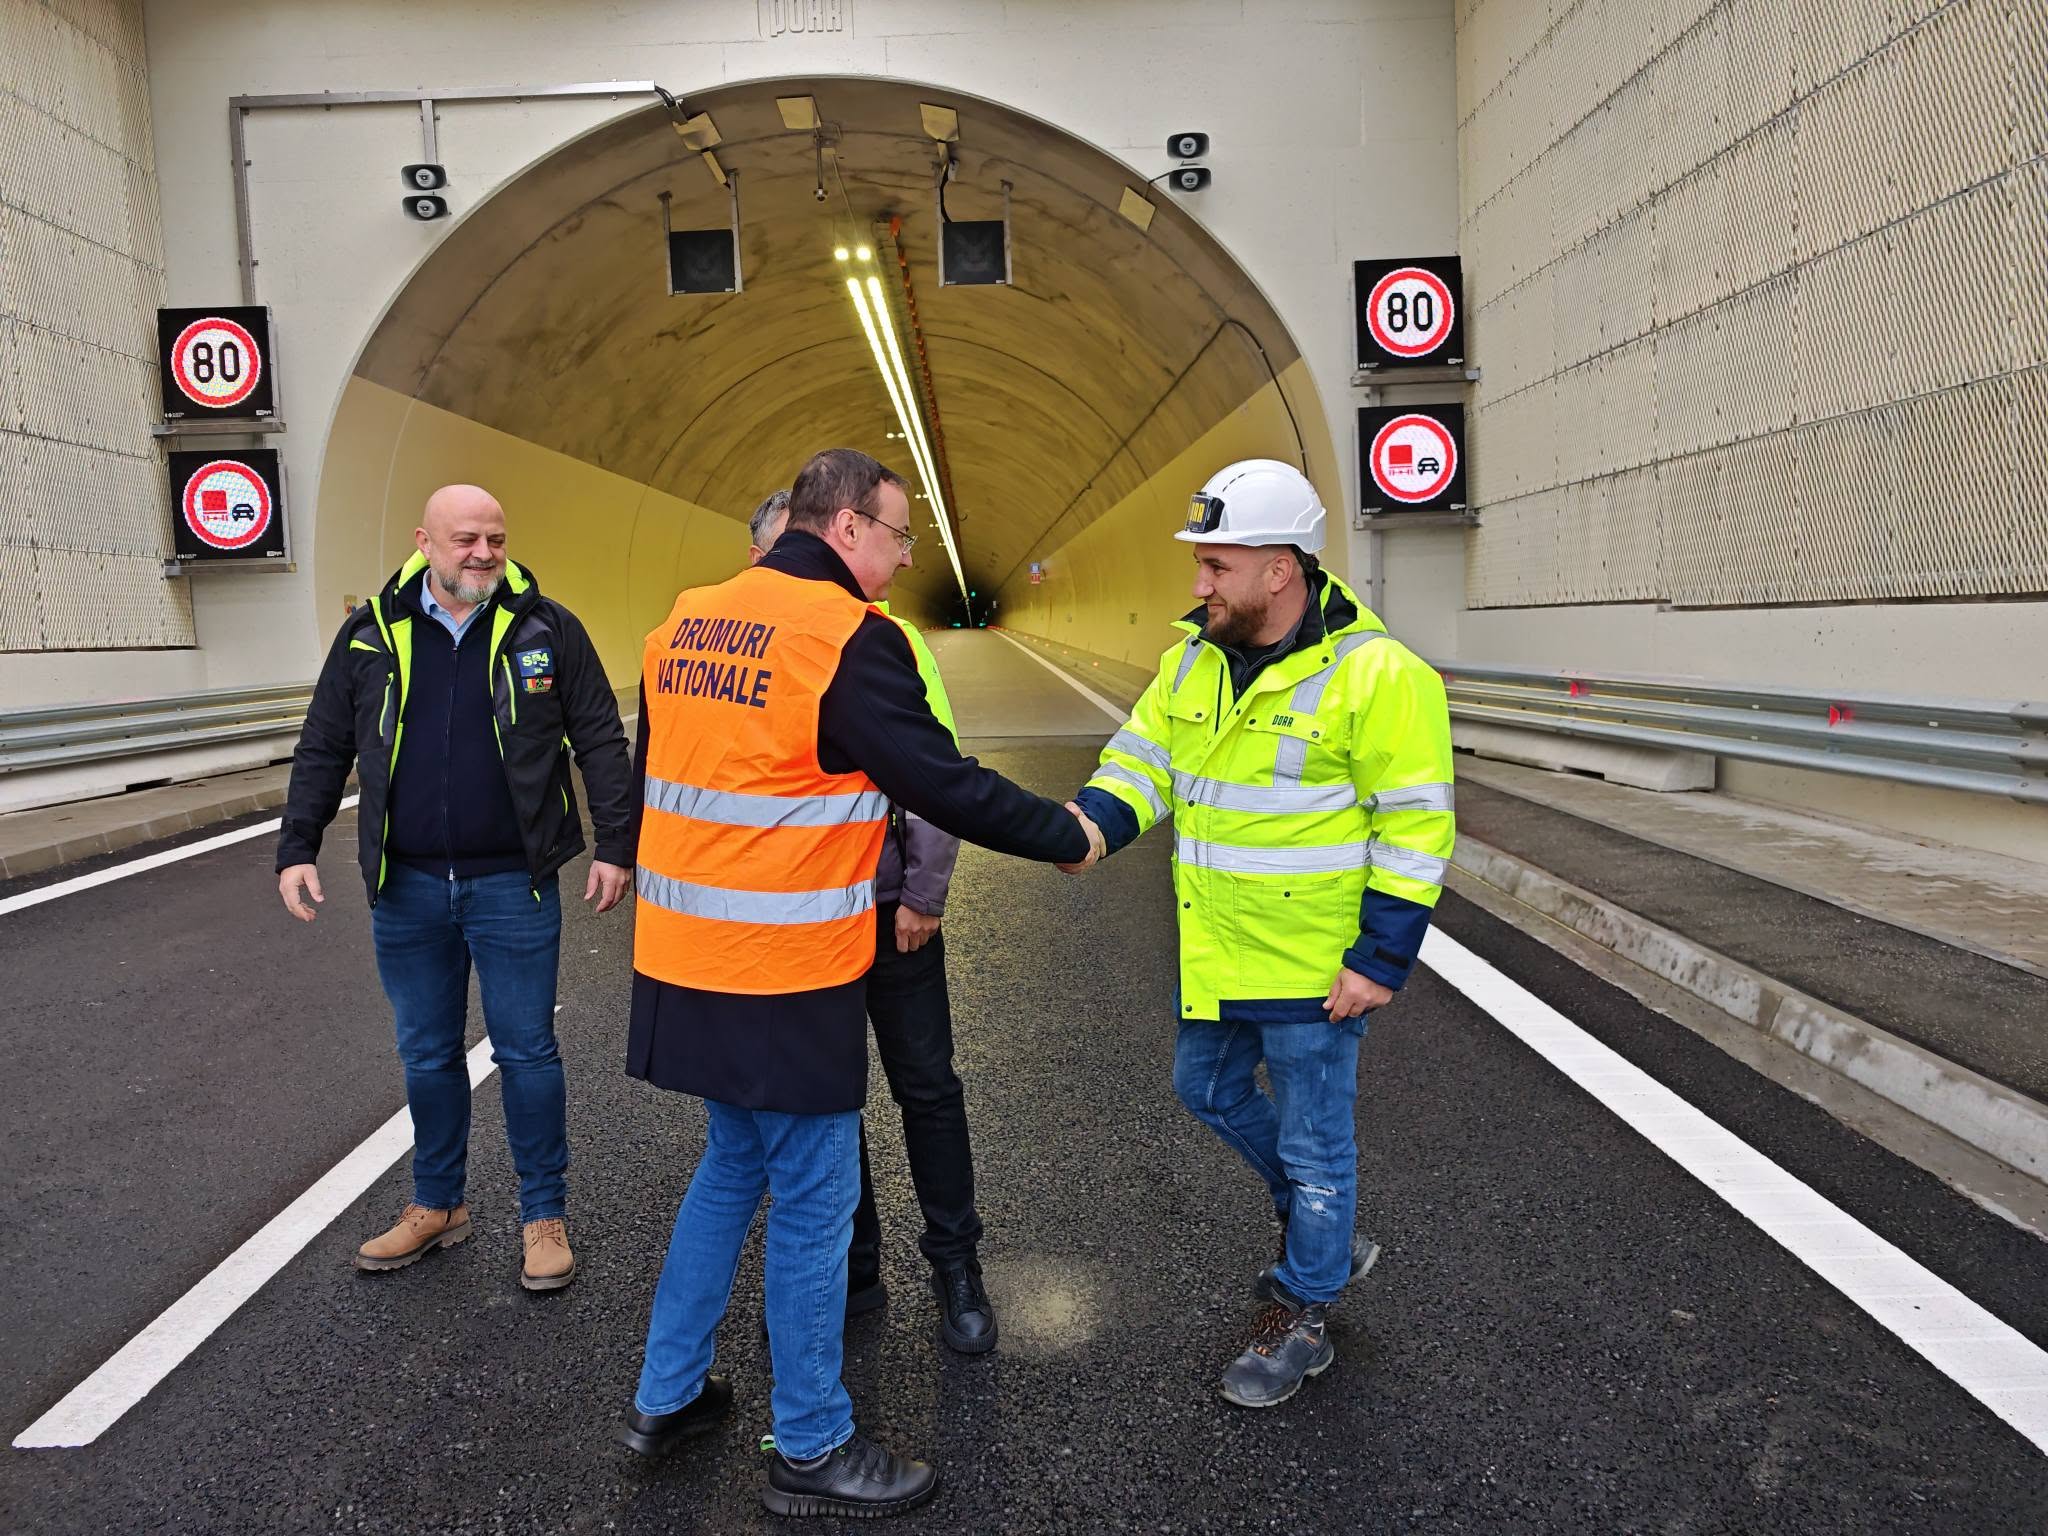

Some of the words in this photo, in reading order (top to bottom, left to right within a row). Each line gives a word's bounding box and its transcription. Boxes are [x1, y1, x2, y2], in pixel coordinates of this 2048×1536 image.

[1387, 291, 1433, 333] 80
[192, 341, 241, 383] 80
[670, 618, 776, 659] DRUMURI
